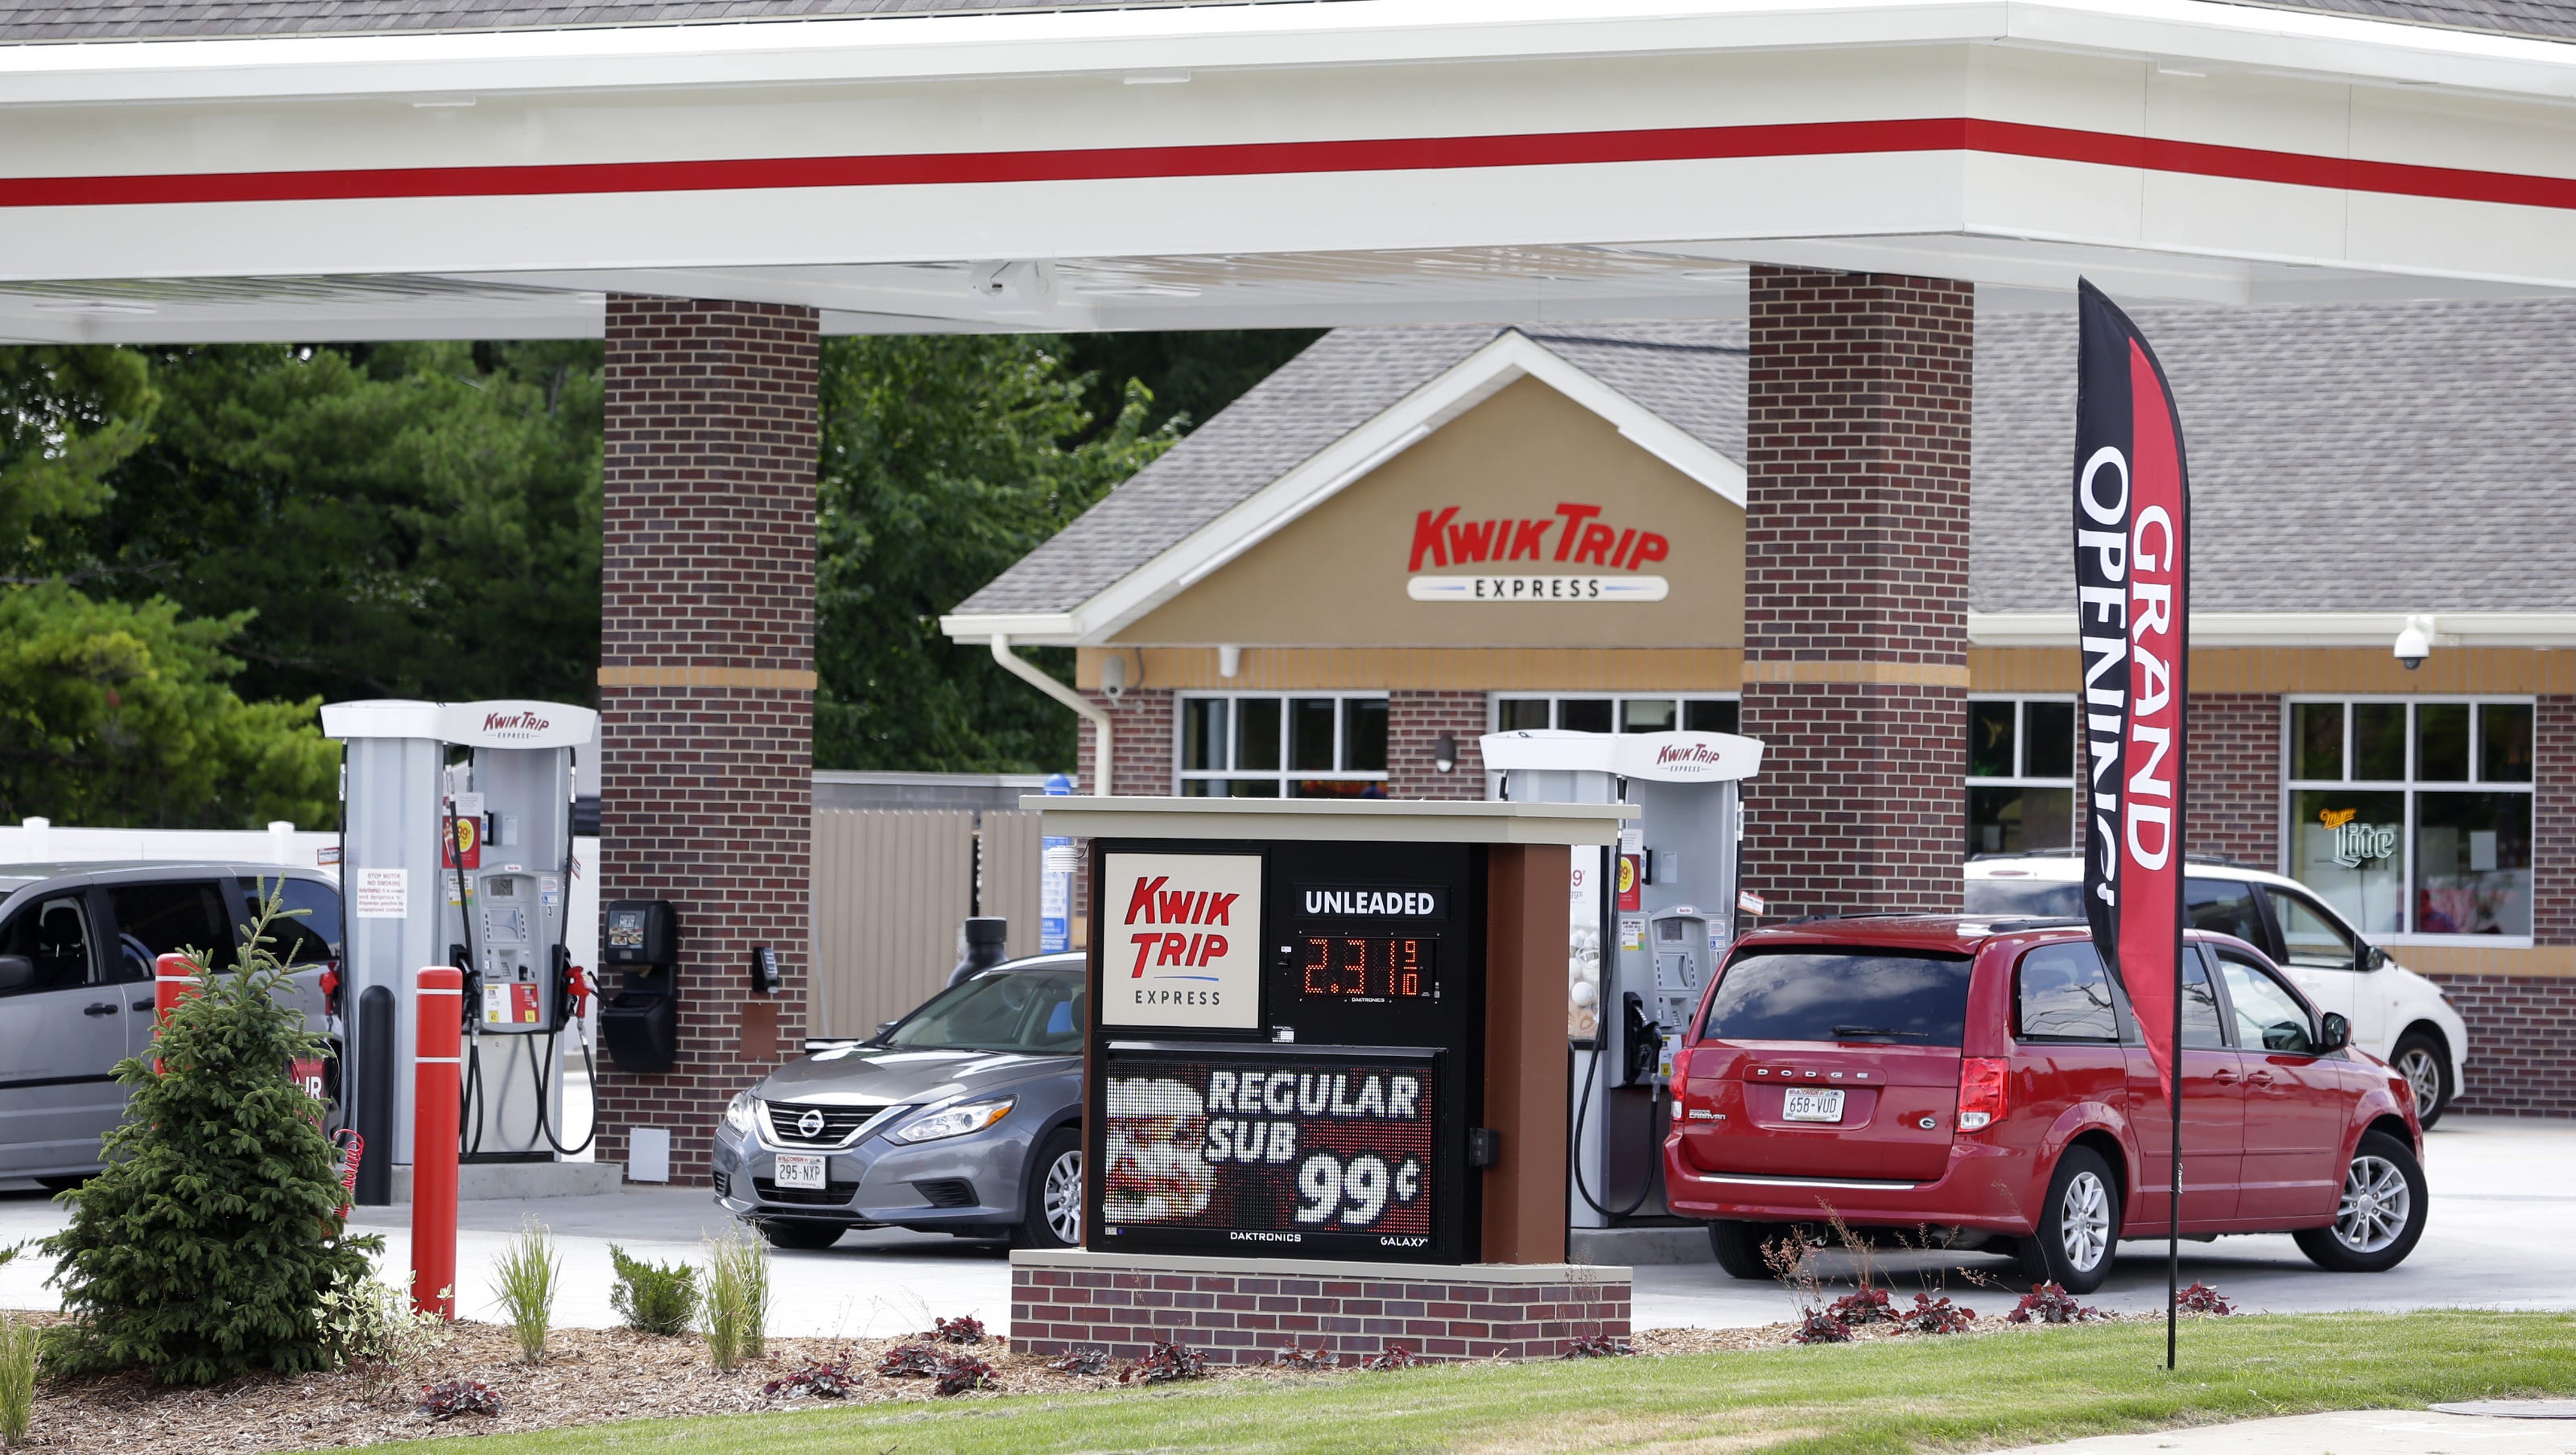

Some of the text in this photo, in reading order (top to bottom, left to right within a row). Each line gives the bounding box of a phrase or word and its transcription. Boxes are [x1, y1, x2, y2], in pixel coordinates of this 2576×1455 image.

[1408, 502, 1670, 572] KWIK TRIP
[1476, 579, 1599, 597] EXPRESS
[2127, 505, 2174, 870] GRAND
[483, 711, 550, 732] KWIK TRIP
[1657, 743, 1720, 765] KWIK TRIP
[2332, 822, 2394, 868] Lite
[1124, 876, 1241, 926] KWIK
[1306, 890, 1435, 915] UNLEADED
[1570, 891, 1583, 899] ggs
[1130, 933, 1228, 979] TRIP
[1304, 938, 1396, 995] 2.31
[1135, 990, 1220, 1006] EXPRESS
[1757, 1069, 1868, 1079] DODGE
[1208, 1070, 1418, 1119] REGULAR
[1790, 1097, 1837, 1114] 658-VUD
[1206, 1117, 1297, 1164] SUB
[779, 1164, 820, 1181] 295-NXP
[1230, 1231, 1302, 1243] DAKTRONICS
